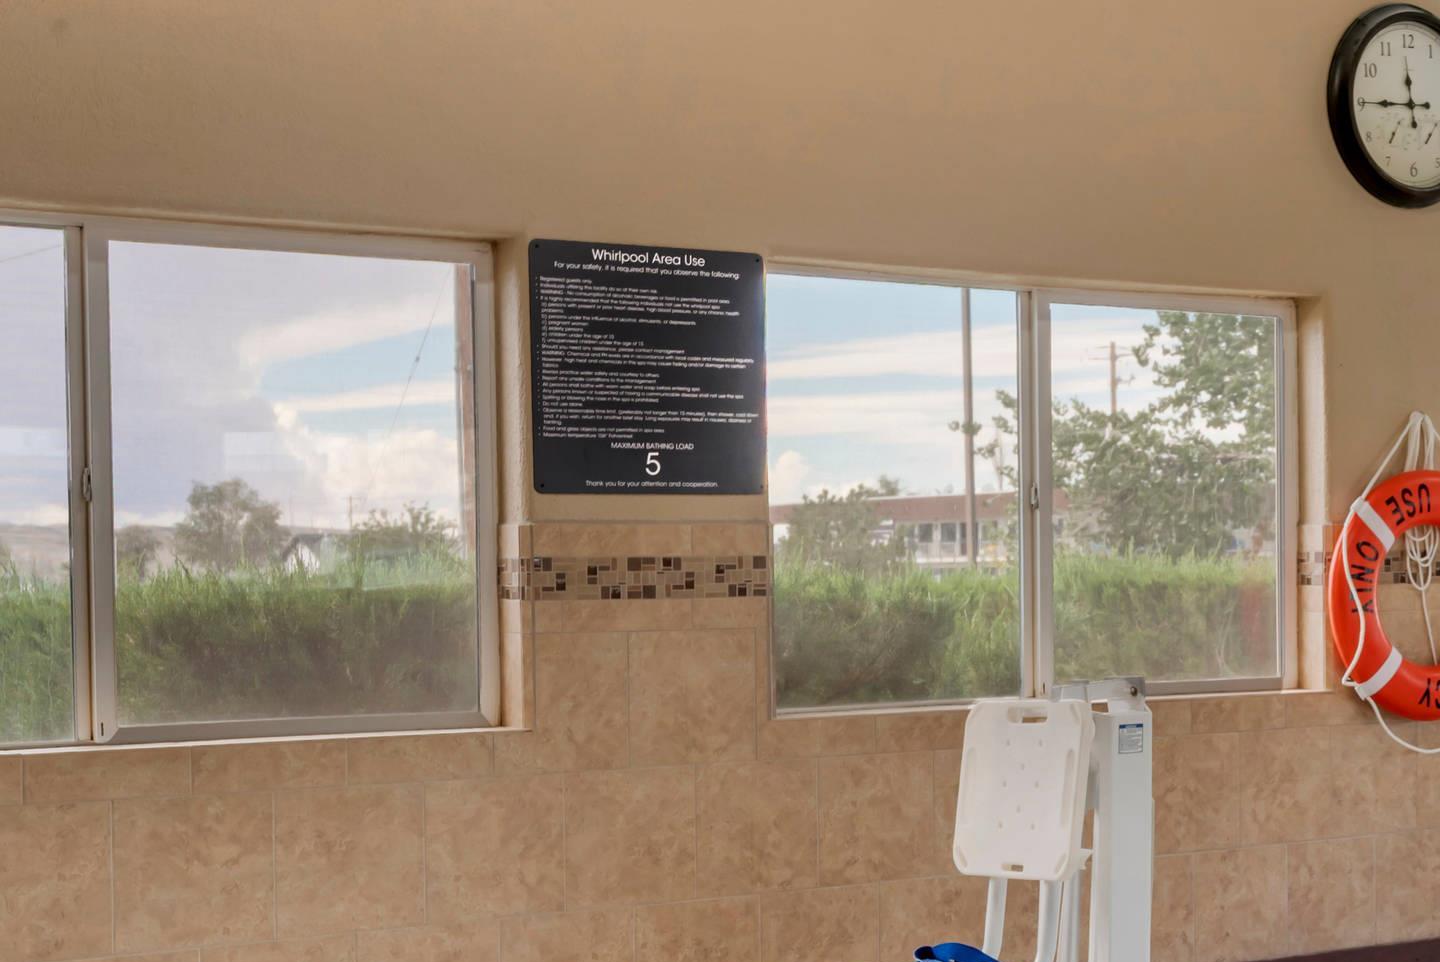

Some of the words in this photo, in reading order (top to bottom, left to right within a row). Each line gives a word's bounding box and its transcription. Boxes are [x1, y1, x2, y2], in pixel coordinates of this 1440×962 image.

[1380, 41, 1391, 57] 11
[1402, 33, 1415, 49] 12
[1428, 44, 1433, 59] 1
[1363, 62, 1377, 78] 10
[1357, 97, 1365, 112] 9
[1366, 131, 1372, 143] 8
[1385, 156, 1391, 167] 7
[1435, 157, 1440, 169] 5
[1410, 162, 1418, 178] 6
[592, 248, 649, 264] Whirlpool
[652, 252, 681, 266] Area
[684, 254, 706, 267] Use
[554, 260, 564, 268] For
[617, 265, 644, 273] required
[673, 269, 699, 277] observe
[646, 442, 674, 450] BATHING
[645, 452, 661, 476] 5
[1385, 483, 1431, 526] USE
